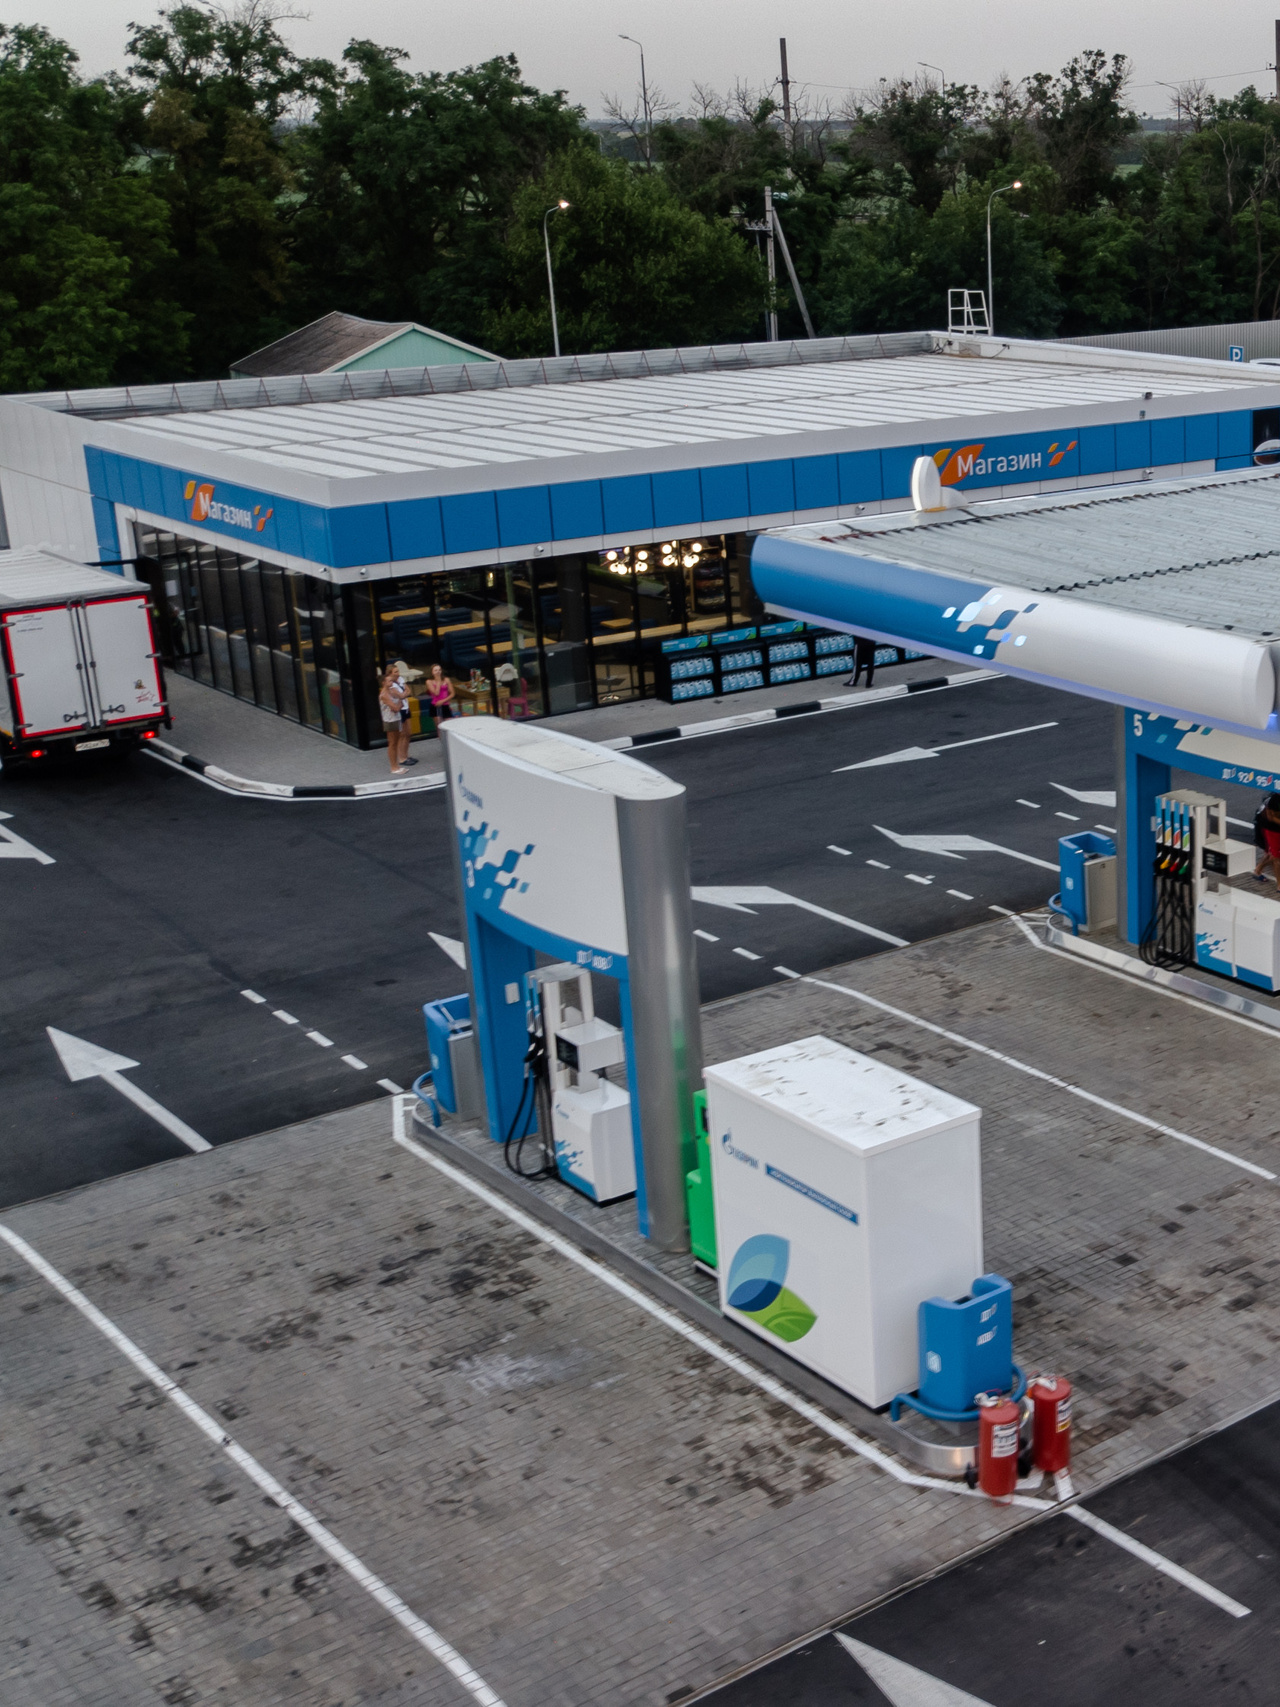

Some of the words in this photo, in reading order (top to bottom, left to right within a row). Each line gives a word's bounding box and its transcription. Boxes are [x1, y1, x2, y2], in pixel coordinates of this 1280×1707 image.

[1232, 348, 1241, 361] P
[957, 452, 1042, 478] Магазин
[199, 492, 253, 530] Магазин
[1133, 713, 1143, 737] 5
[1237, 771, 1250, 784] 92
[1255, 775, 1268, 788] 95
